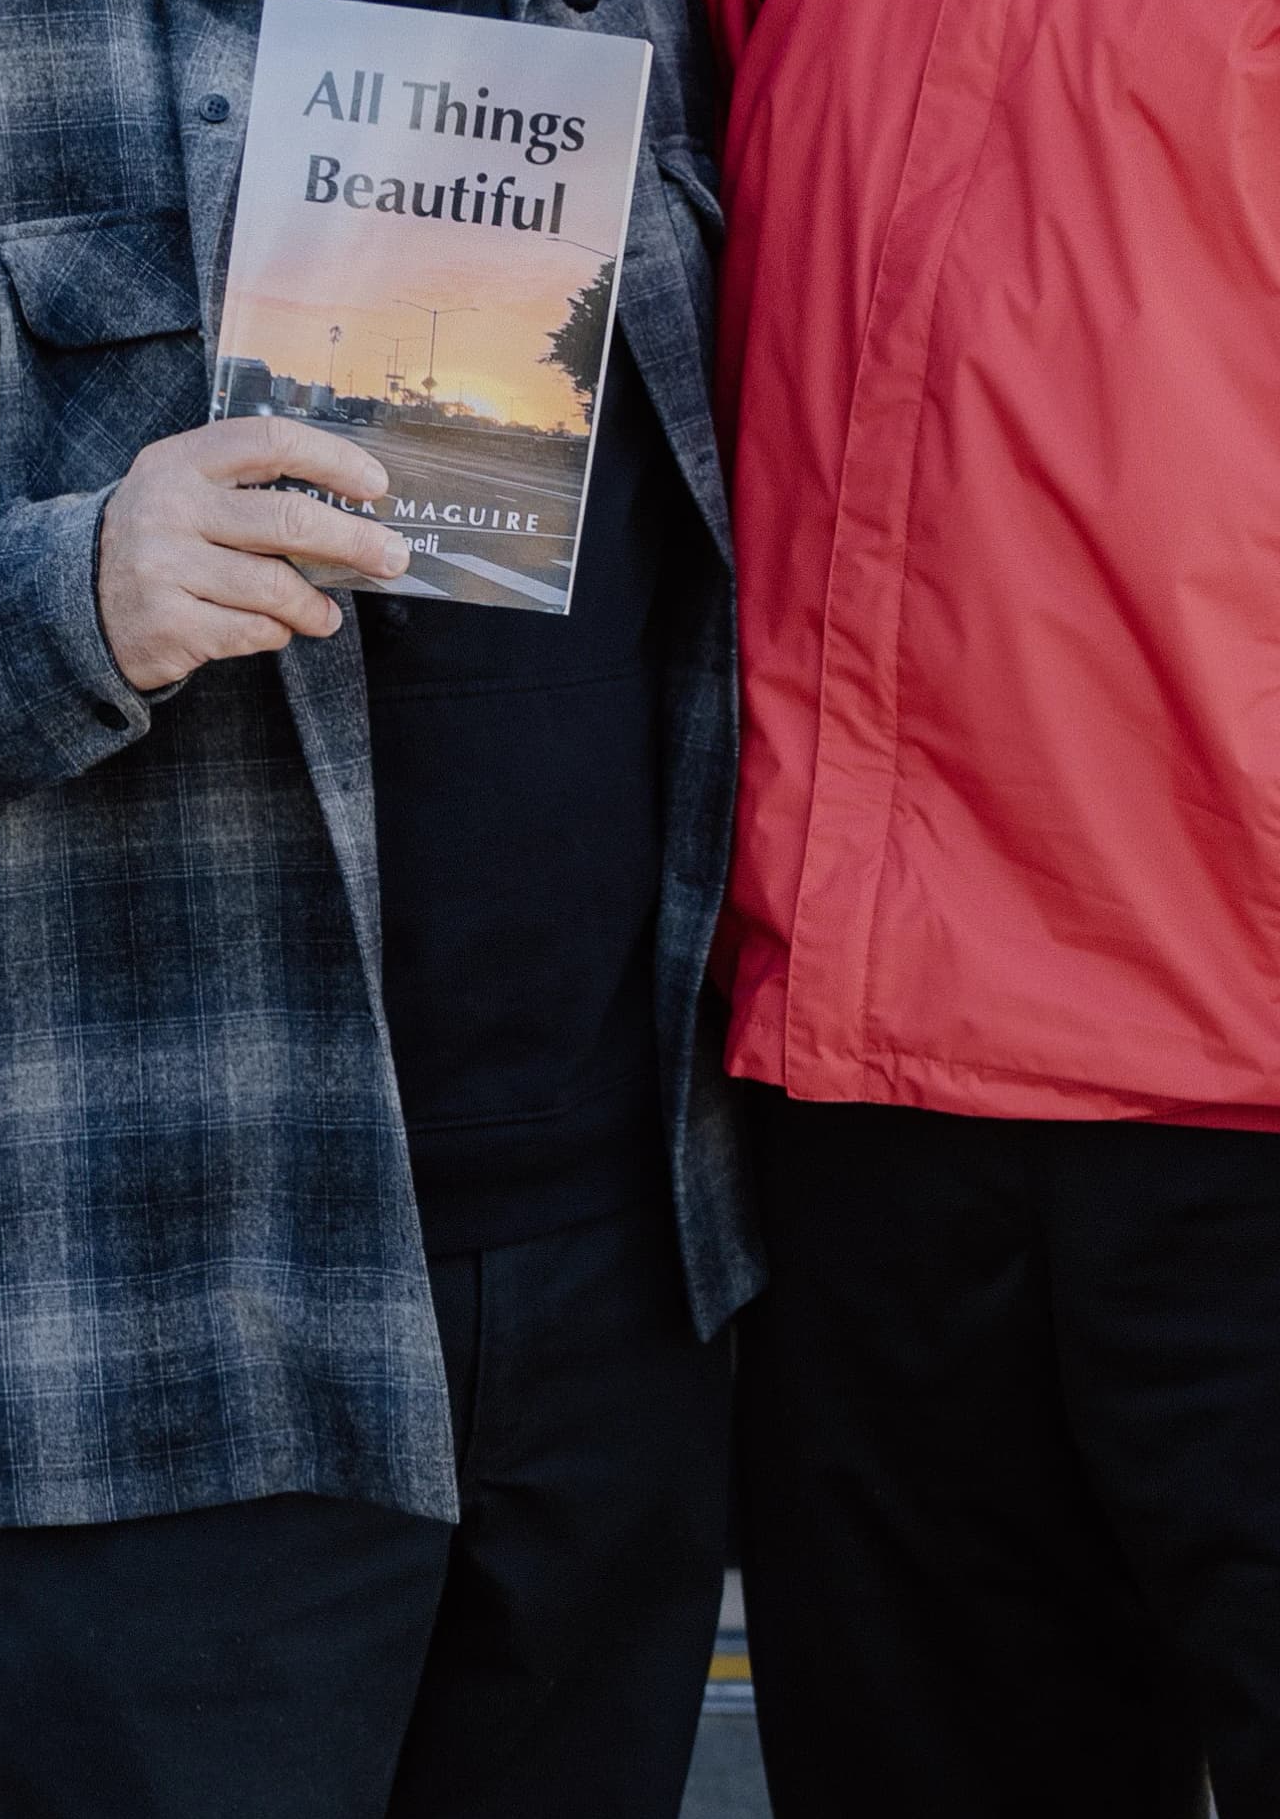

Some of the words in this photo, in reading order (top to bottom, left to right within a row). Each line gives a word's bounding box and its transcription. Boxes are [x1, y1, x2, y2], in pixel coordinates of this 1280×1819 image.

[303, 69, 385, 124] All
[402, 80, 586, 165] Things
[304, 154, 566, 234] Beautiful
[394, 499, 540, 532] MAGUIRE
